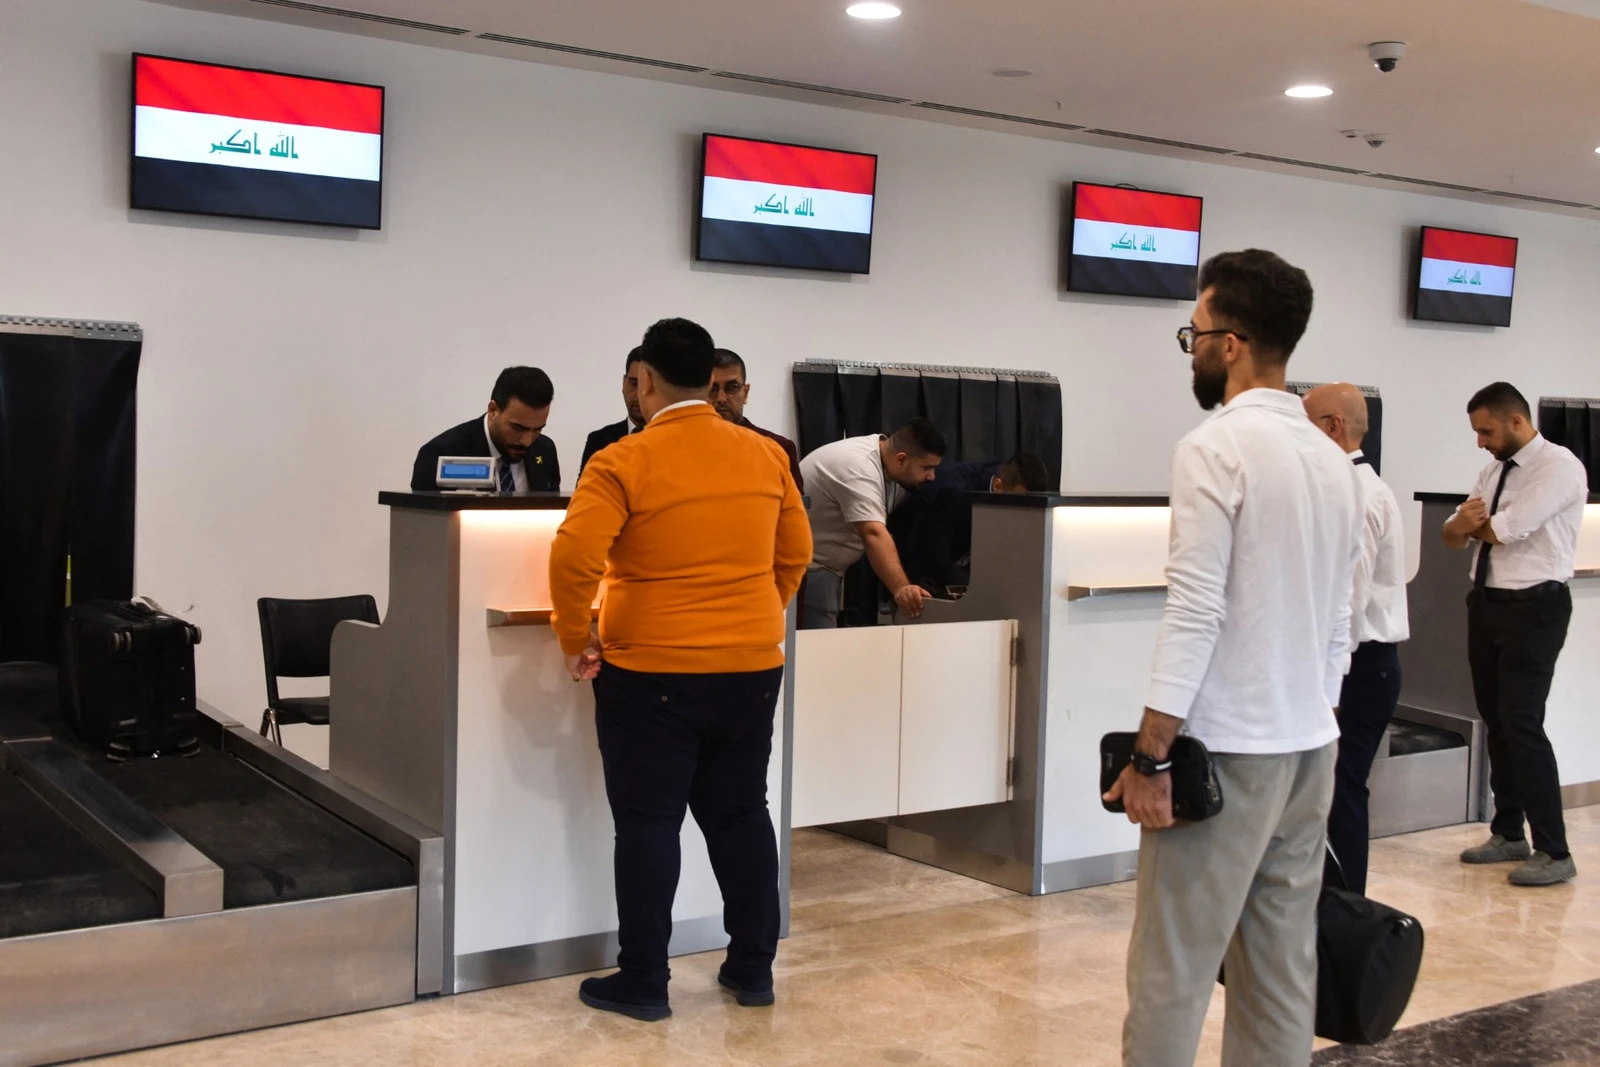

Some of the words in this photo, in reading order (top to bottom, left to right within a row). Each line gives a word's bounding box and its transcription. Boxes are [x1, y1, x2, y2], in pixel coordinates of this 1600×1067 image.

[269, 131, 299, 159] الله
[794, 195, 815, 217] الله
[1141, 233, 1156, 252] الله
